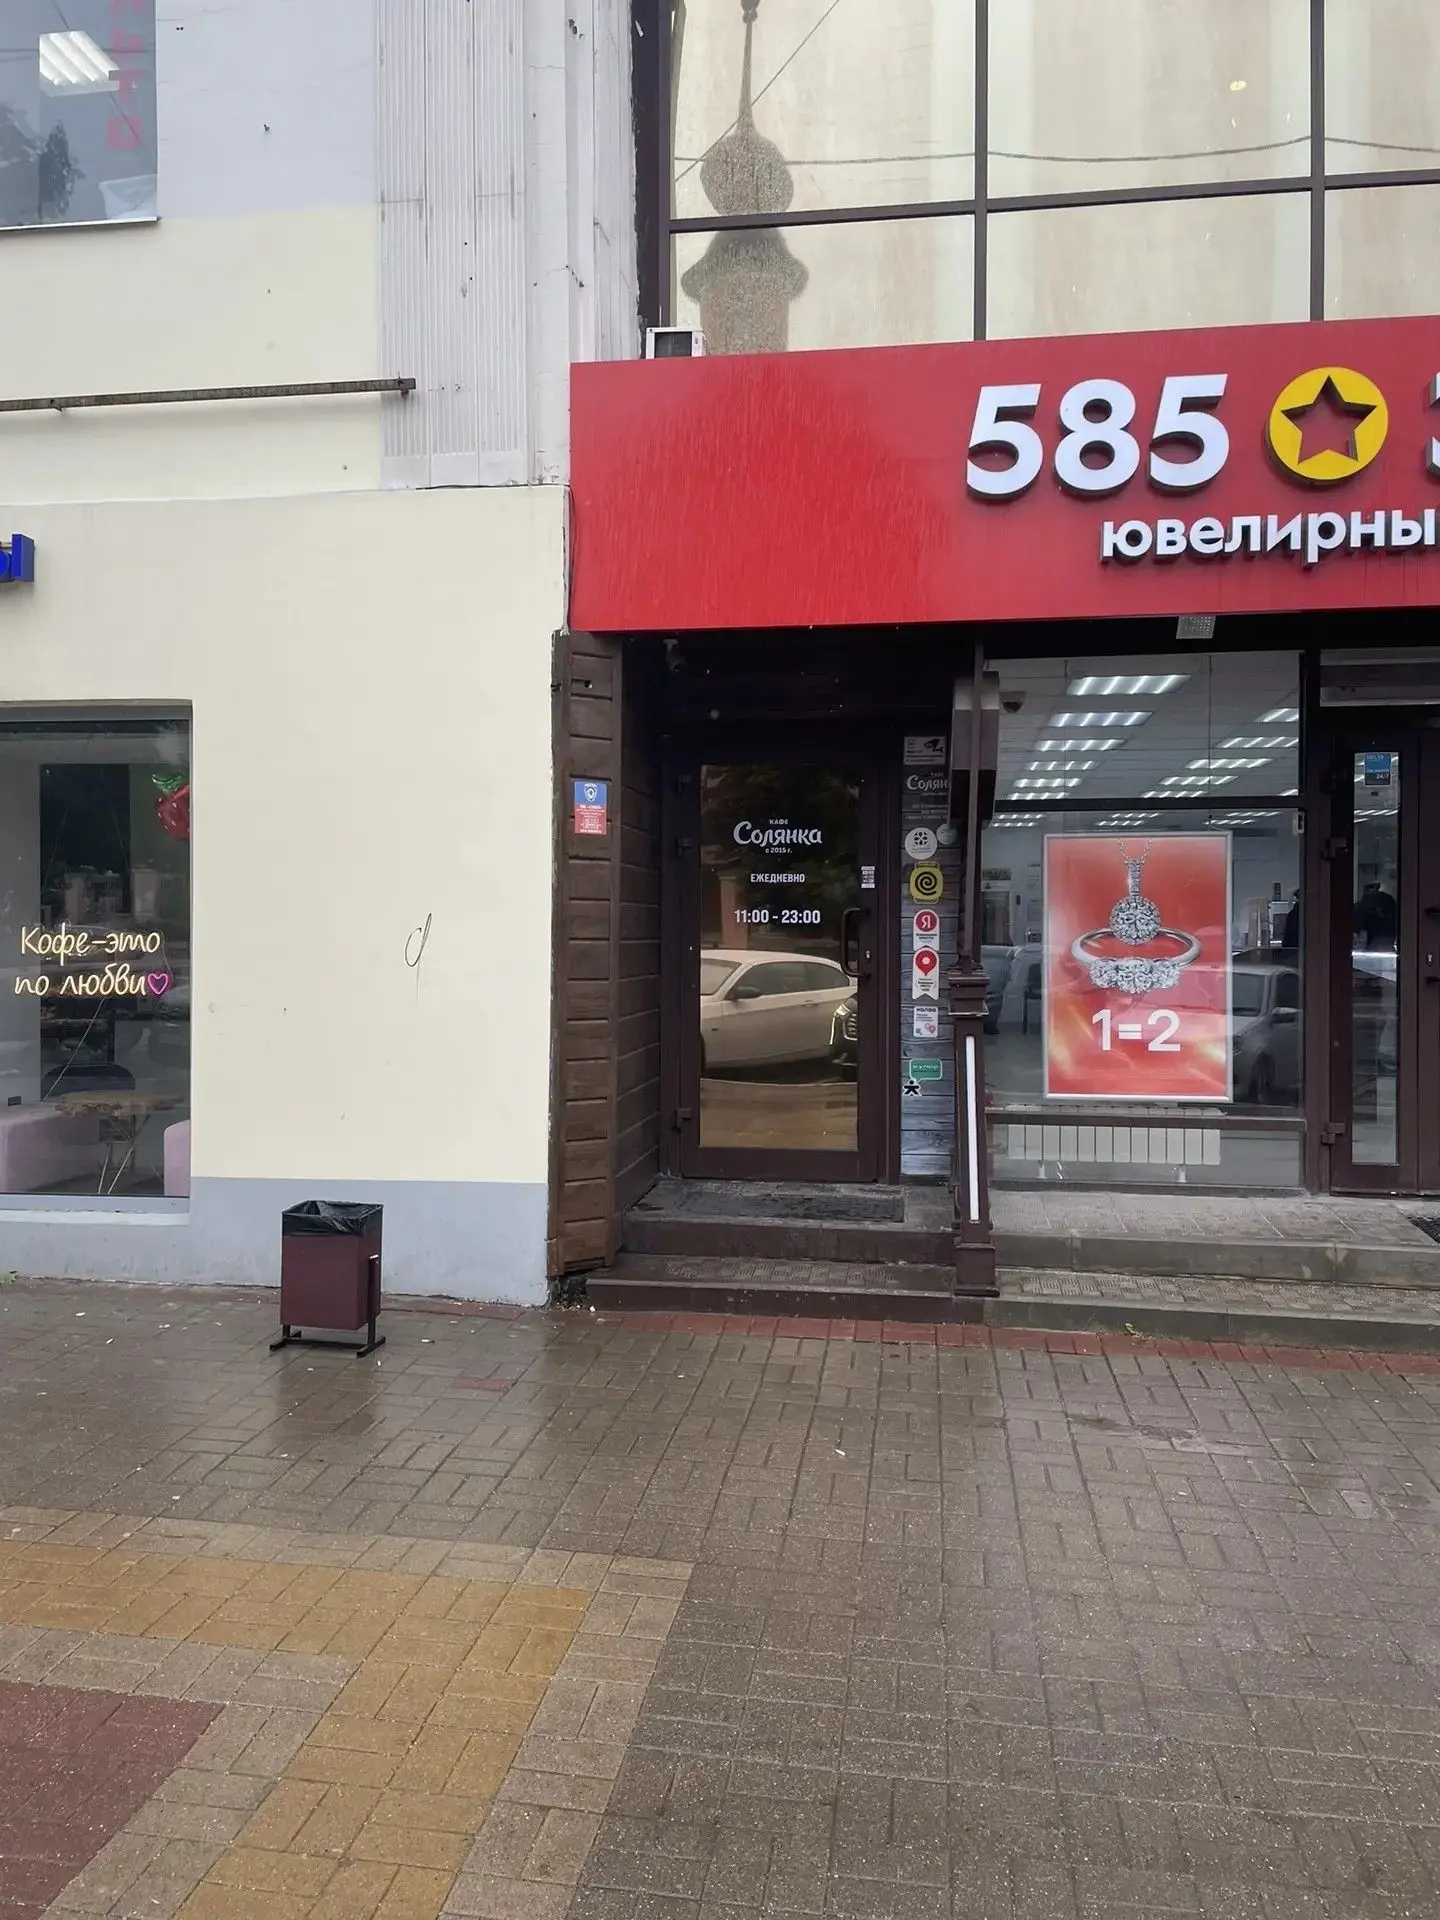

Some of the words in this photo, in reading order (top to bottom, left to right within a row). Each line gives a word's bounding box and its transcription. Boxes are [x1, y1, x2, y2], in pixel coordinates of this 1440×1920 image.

[966, 373, 1230, 497] 585
[1102, 508, 1437, 564] ювелирны
[733, 821, 822, 847] Солянка
[750, 873, 805, 883] ЕЖЕДНЕВНО
[734, 909, 769, 923] 11:00
[780, 909, 821, 923] 23:00
[921, 914, 931, 928] Я
[15, 975, 49, 996] по
[60, 963, 146, 996] любви
[1091, 1008, 1181, 1051] 1=2
